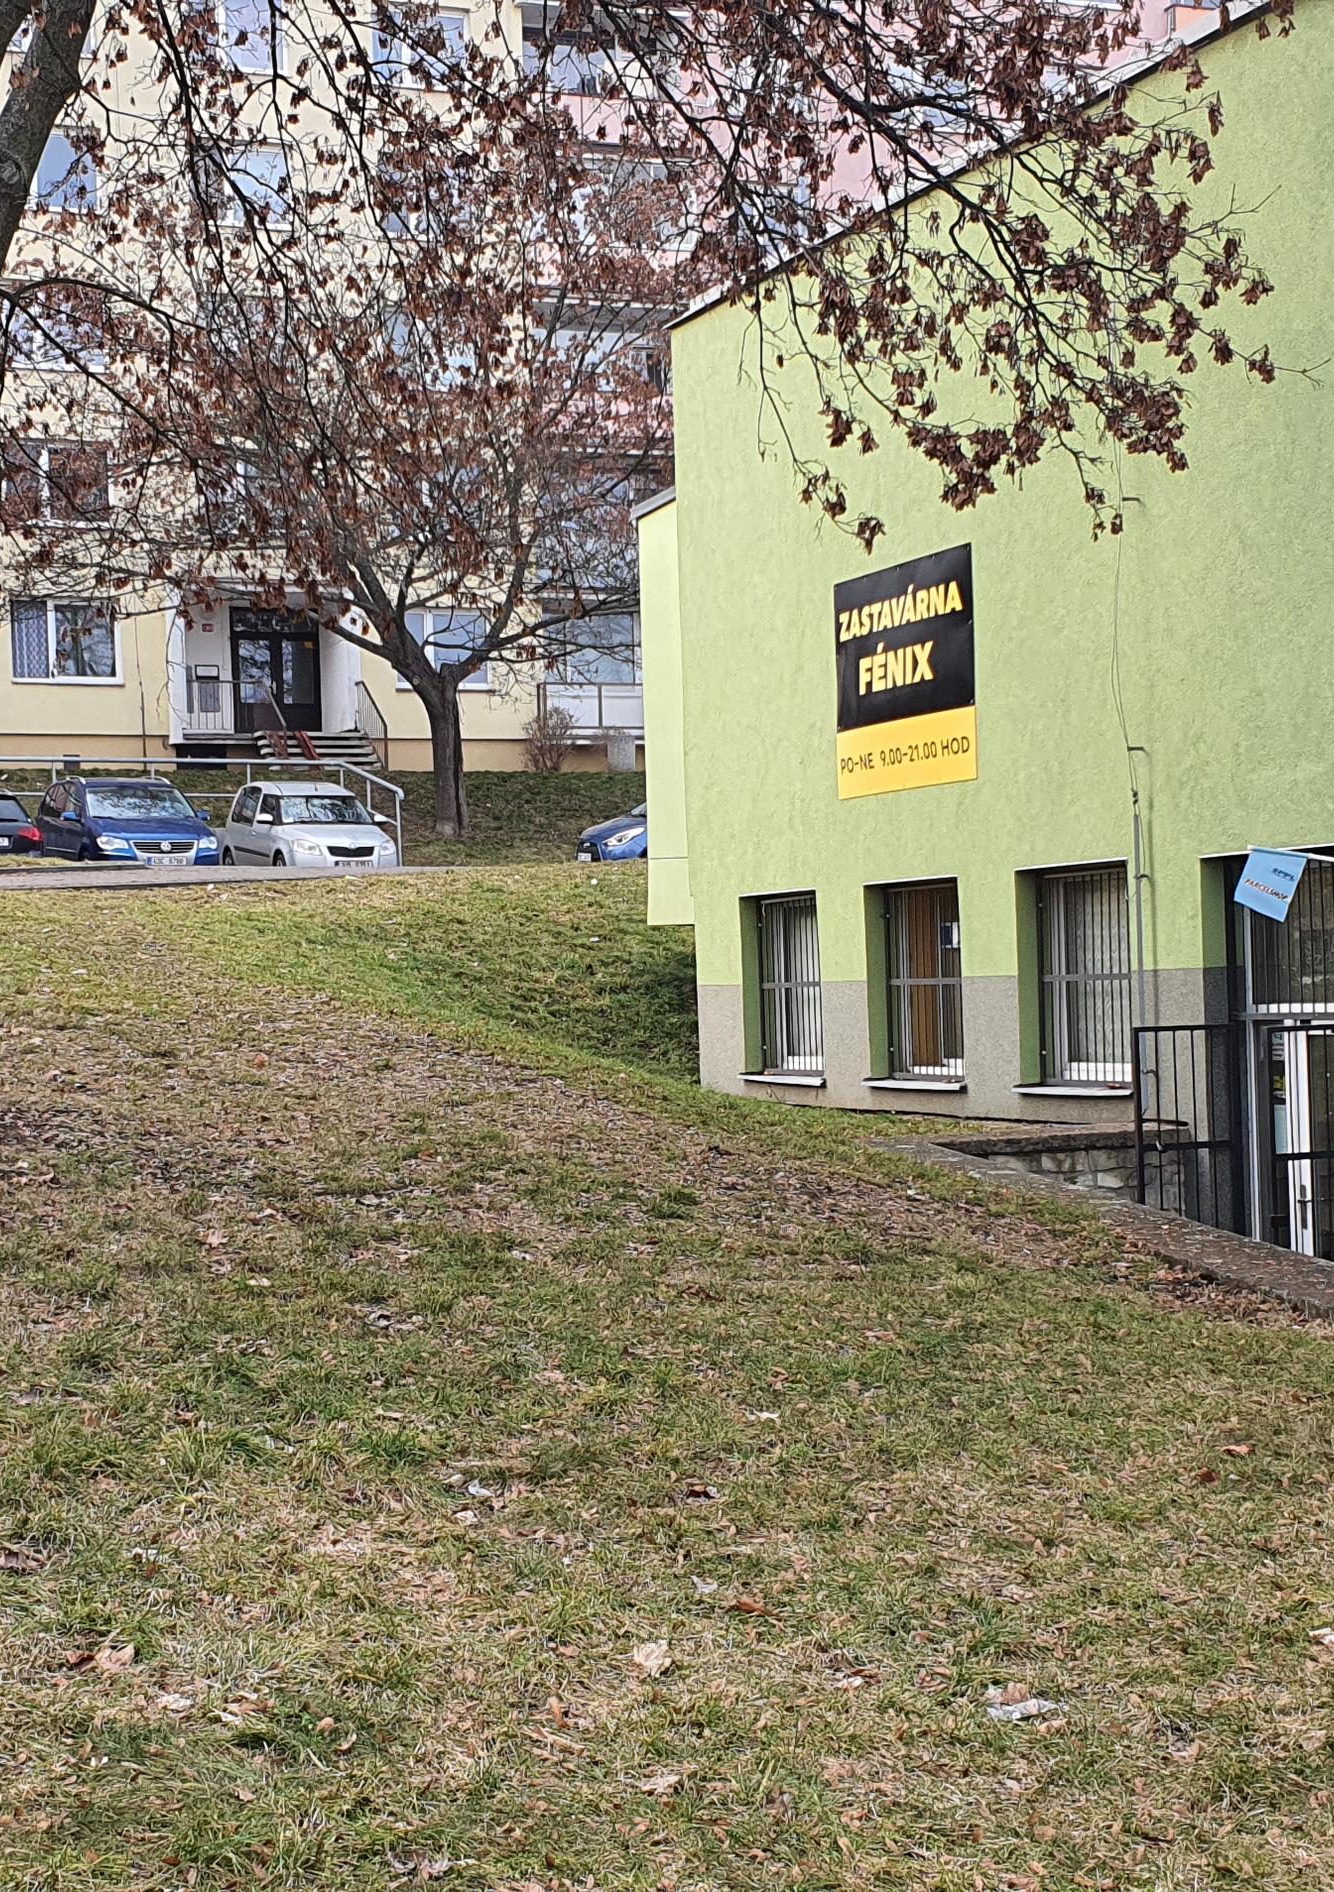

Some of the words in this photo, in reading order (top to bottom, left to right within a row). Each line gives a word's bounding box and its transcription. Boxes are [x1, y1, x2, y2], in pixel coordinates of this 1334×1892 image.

[839, 583, 963, 642] ZASTAVÁRNA
[859, 641, 934, 696] FÉNIX
[840, 751, 875, 775] PO-NE
[880, 740, 938, 767] 9.00-21.00
[940, 735, 970, 758] HOD
